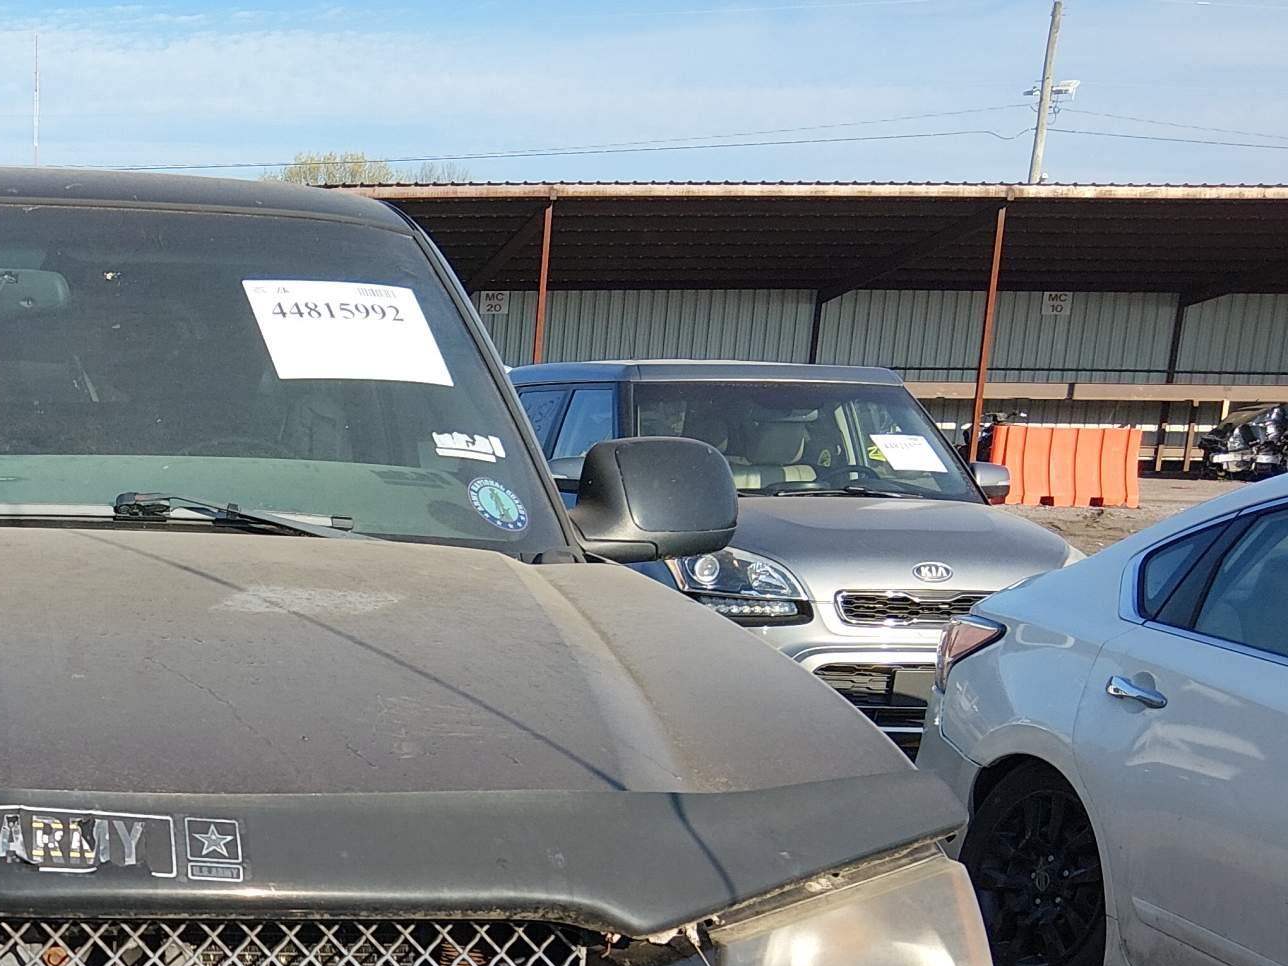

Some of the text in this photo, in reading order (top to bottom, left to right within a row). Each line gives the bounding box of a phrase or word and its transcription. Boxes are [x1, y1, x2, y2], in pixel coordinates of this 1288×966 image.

[485, 292, 505, 302] MC
[1048, 293, 1068, 302] MC
[272, 301, 404, 323] 44815992
[486, 303, 502, 313] 20
[1049, 304, 1064, 313] 10
[920, 565, 948, 577] KIA
